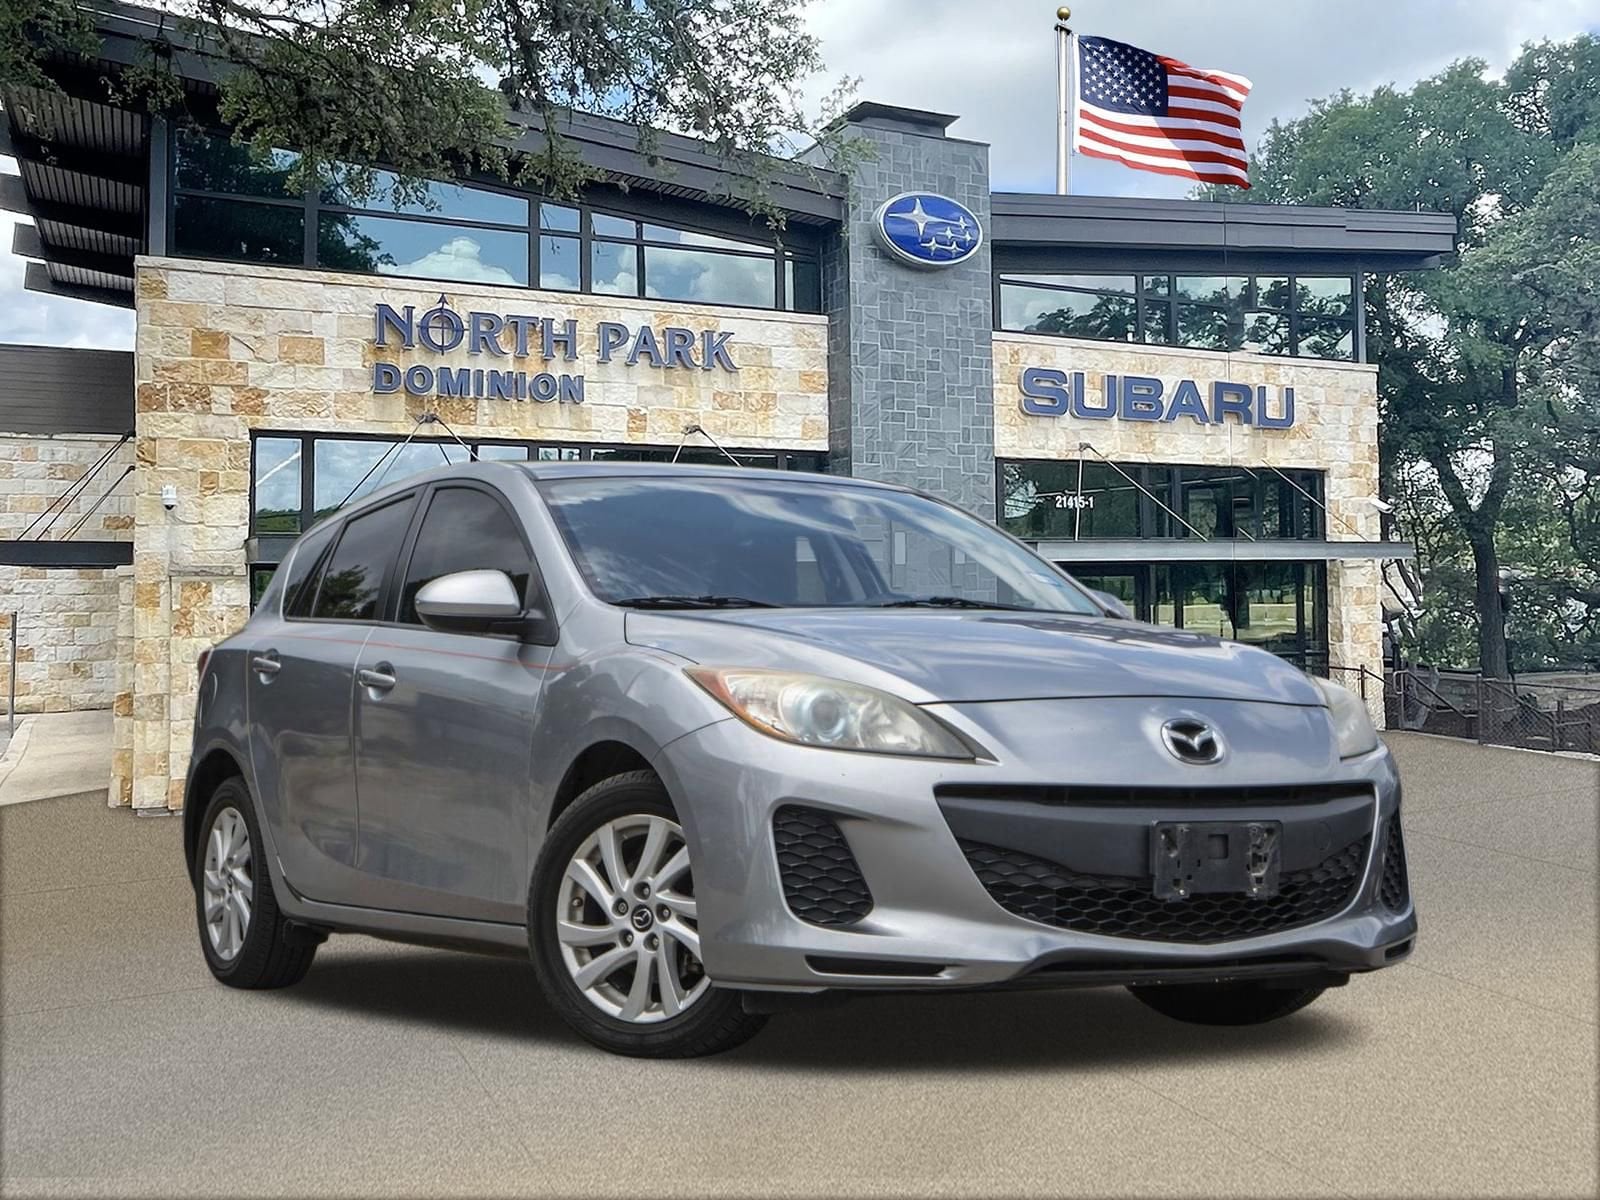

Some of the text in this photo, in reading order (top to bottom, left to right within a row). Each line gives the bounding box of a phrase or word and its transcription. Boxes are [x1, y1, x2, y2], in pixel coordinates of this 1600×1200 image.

[374, 294, 741, 372] NORTH PARK
[373, 362, 585, 403] DOMINION
[1019, 367, 1295, 429] SUBARU
